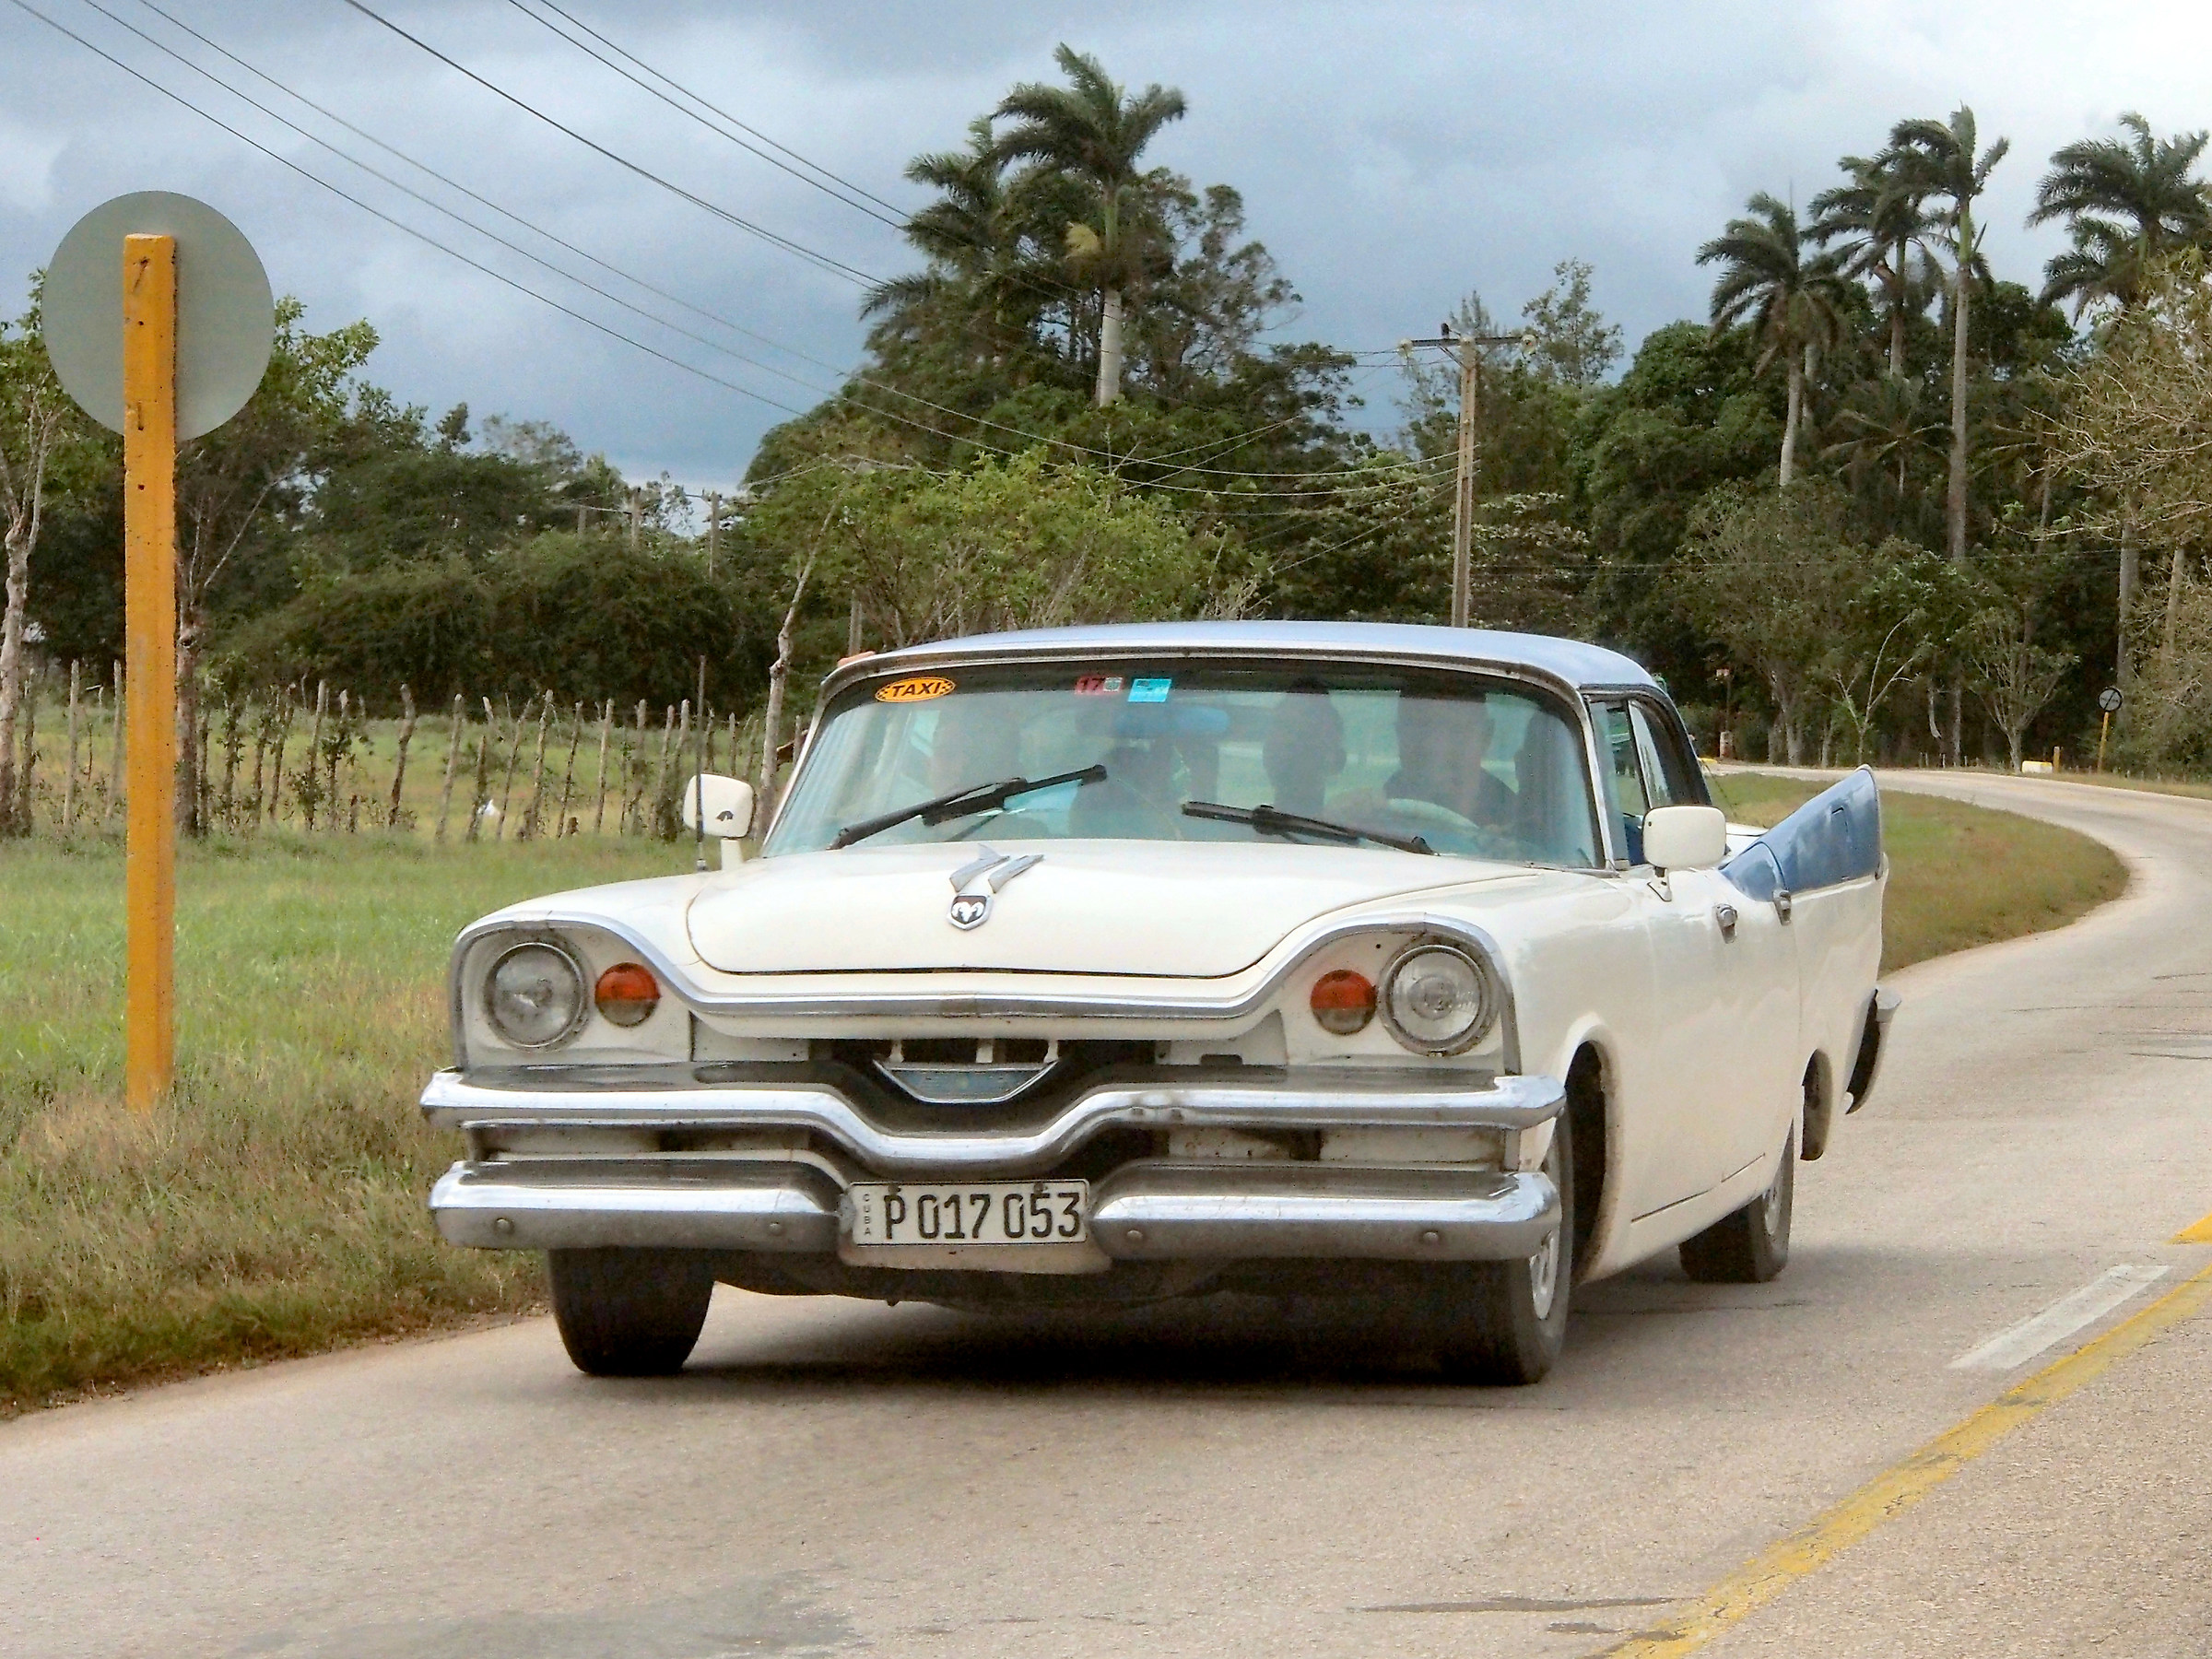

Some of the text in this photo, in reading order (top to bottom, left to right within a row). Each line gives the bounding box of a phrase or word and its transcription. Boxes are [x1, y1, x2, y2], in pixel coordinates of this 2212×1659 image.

[891, 681, 942, 698] TAXI
[862, 1193, 872, 1236] CUBA
[884, 1193, 1080, 1239] P 017 053
